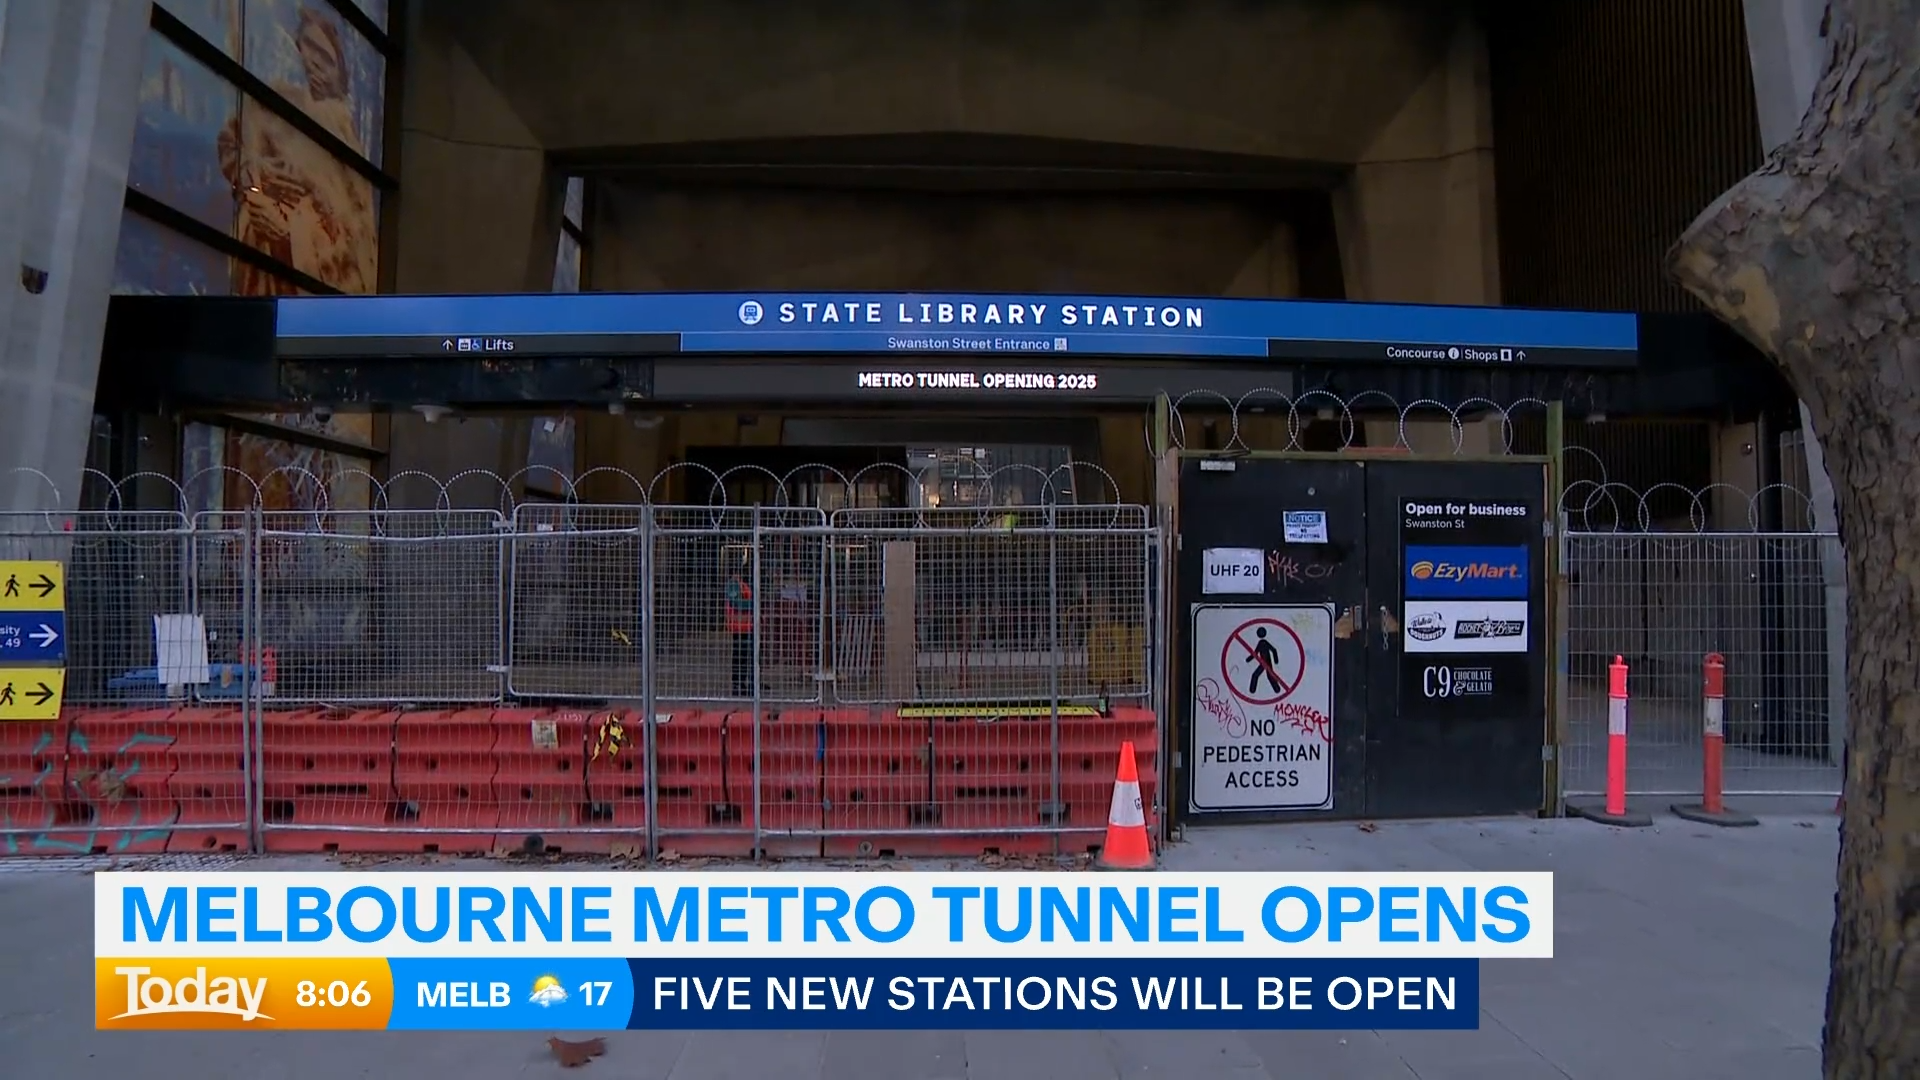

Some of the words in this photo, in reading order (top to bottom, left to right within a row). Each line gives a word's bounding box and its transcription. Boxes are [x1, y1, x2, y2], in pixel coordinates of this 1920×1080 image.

[779, 303, 882, 322] STATE
[899, 304, 1047, 325] LIBRARY
[1061, 306, 1206, 328] STATION
[485, 339, 514, 351] Lifts
[887, 337, 950, 350] Swanston
[952, 337, 992, 350] Street
[994, 337, 1050, 350] Entrance
[1386, 346, 1446, 359] Concourse
[1464, 349, 1499, 363] Shops
[858, 373, 914, 388] METRO
[916, 373, 980, 388] TUNNEL
[983, 373, 1055, 388] OPENING
[1057, 373, 1097, 388] 2025
[1405, 502, 1443, 517] Open
[1445, 502, 1467, 516] for
[1468, 502, 1527, 517] business
[1405, 518, 1453, 529] Swanston
[1454, 519, 1466, 529] St
[1209, 563, 1241, 578] UHF
[1243, 564, 1261, 578] 20
[1433, 562, 1518, 582] EzyMart
[5, 637, 21, 648] 49
[1423, 665, 1451, 698] C9
[1453, 671, 1493, 681] CHOCOLATE
[1466, 682, 1493, 692] GELATO
[1250, 719, 1276, 737] NO
[1203, 744, 1321, 763] PEDESTRIAN
[1225, 770, 1300, 789] ACCESS
